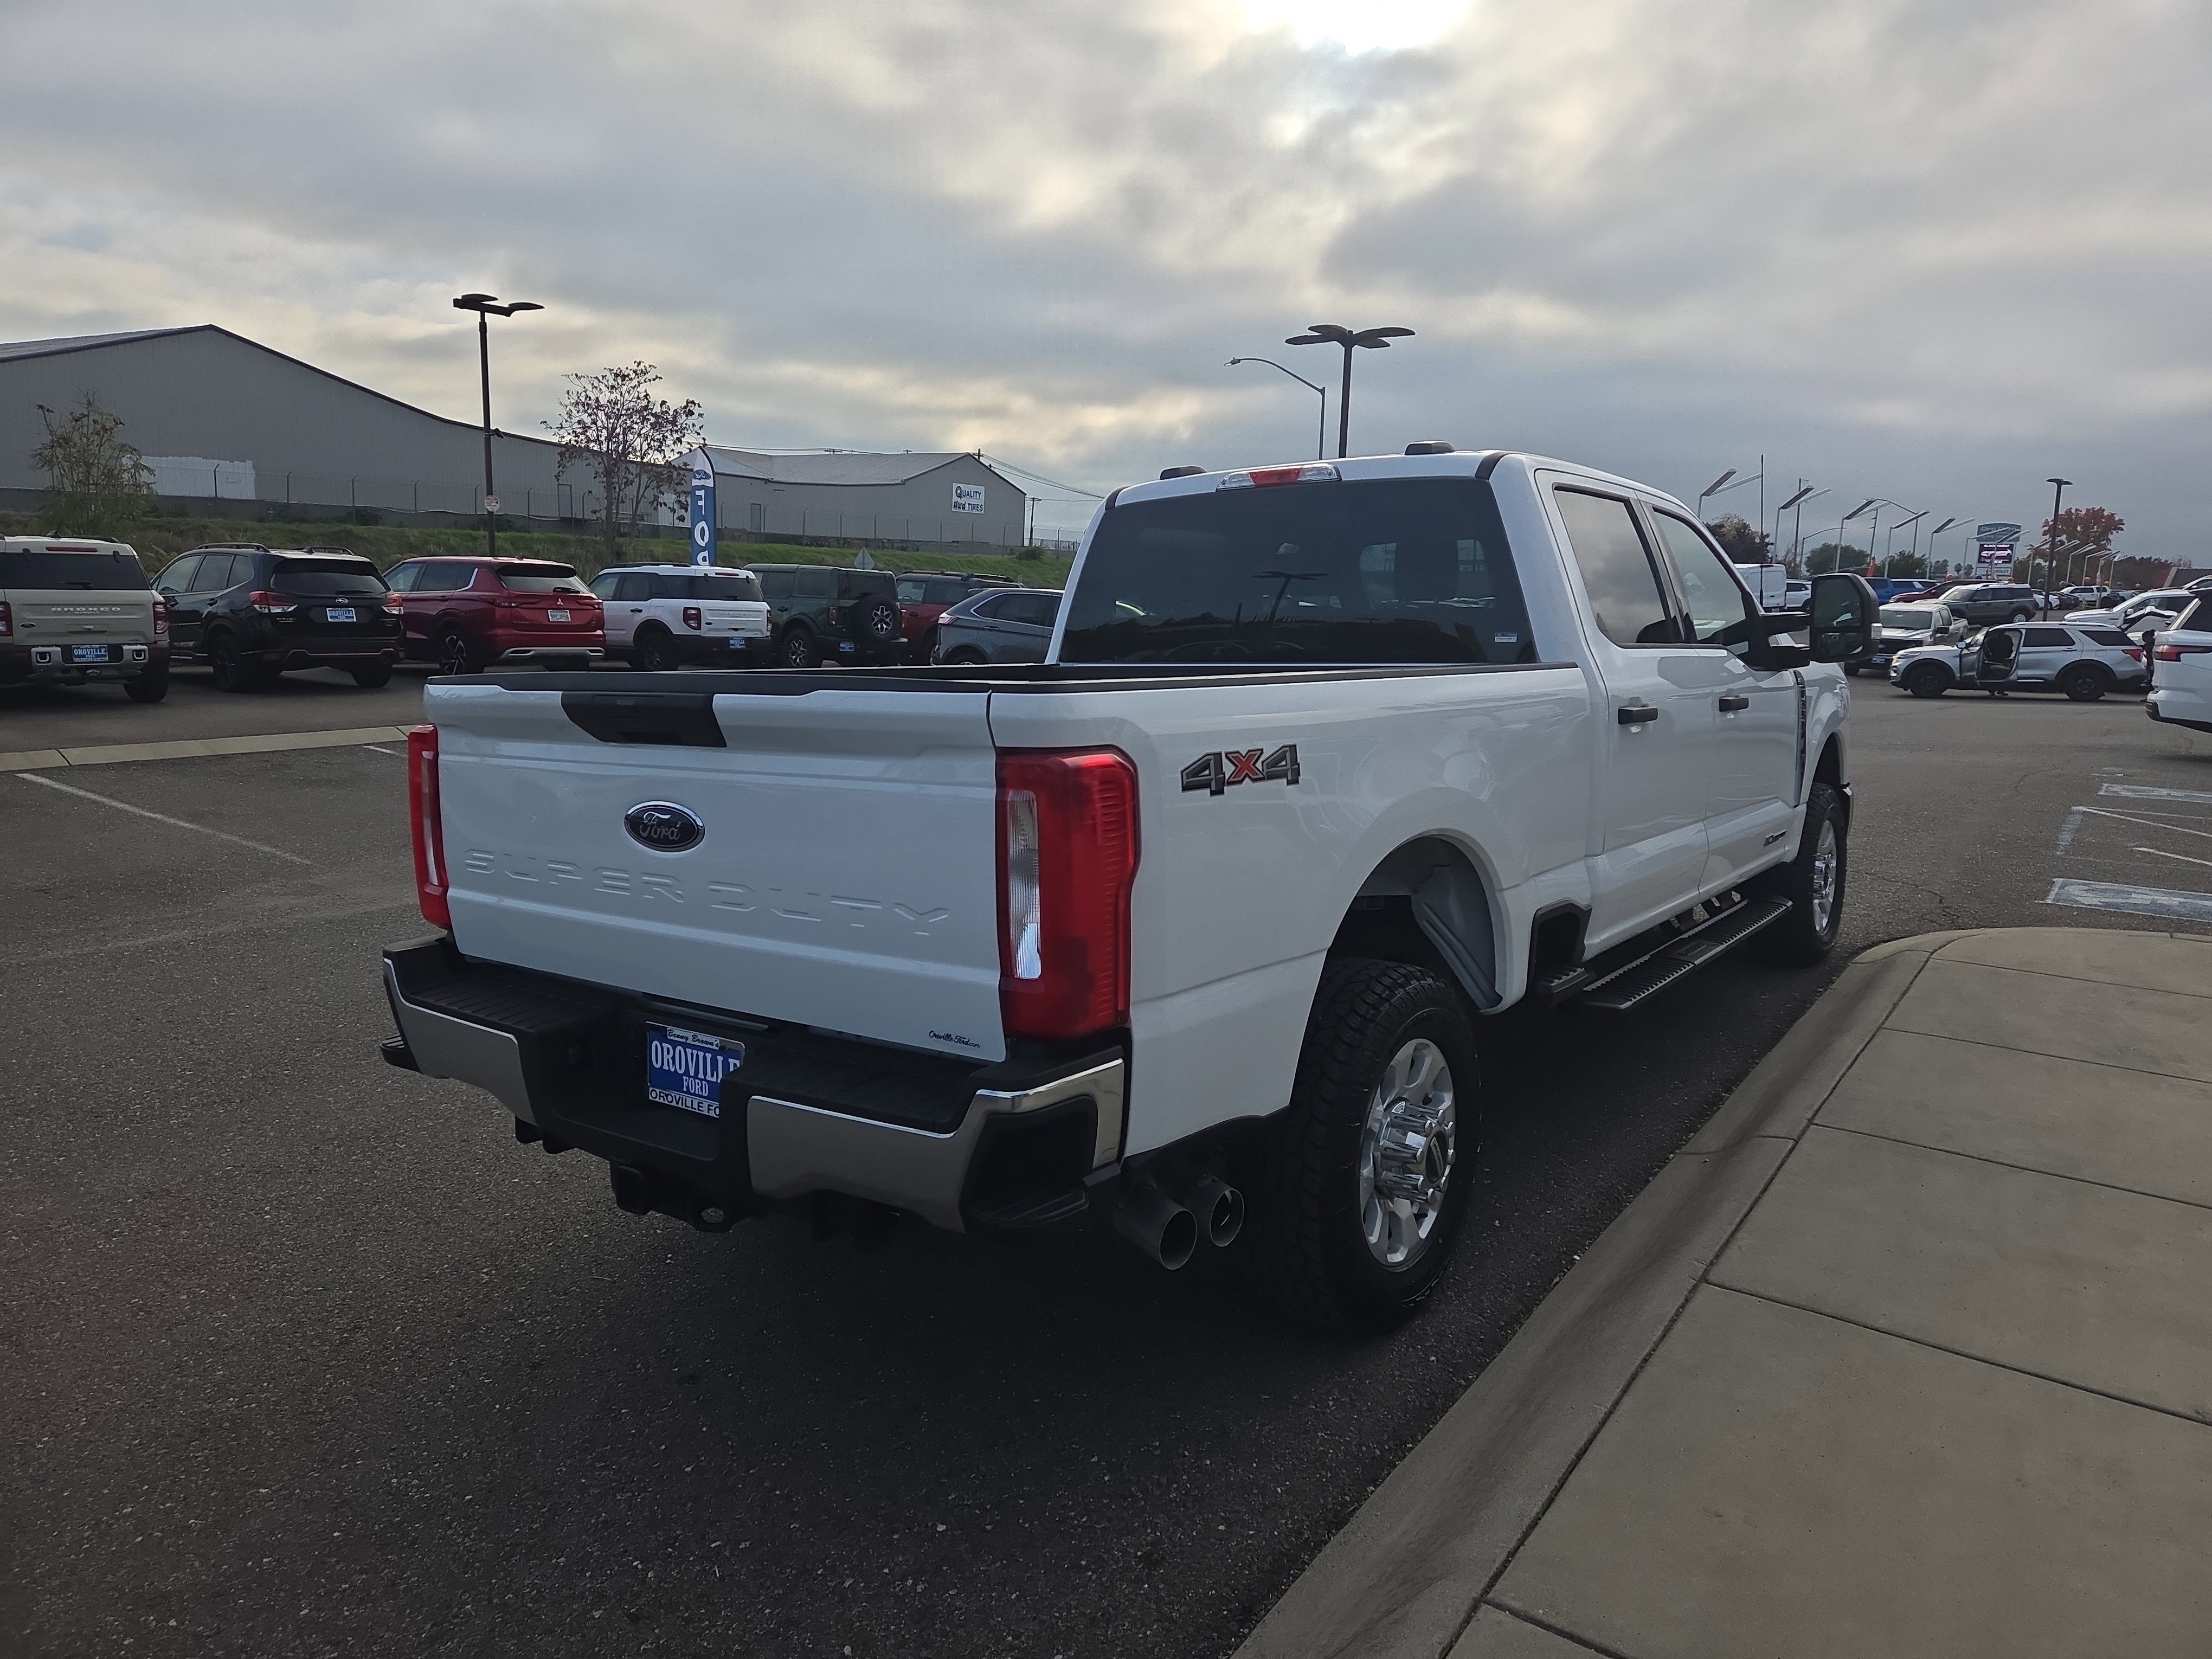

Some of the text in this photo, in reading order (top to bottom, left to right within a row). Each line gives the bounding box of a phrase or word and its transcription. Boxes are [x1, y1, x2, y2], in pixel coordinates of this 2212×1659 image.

[955, 486, 981, 499] QUALITY
[968, 503, 983, 511] TIRES
[639, 811, 681, 841] Ford
[465, 848, 948, 935] SUPER DUTY
[667, 1029, 719, 1047] Benny Brown's
[683, 1076, 709, 1096] FORD
[651, 1089, 704, 1112] OROVILLE
